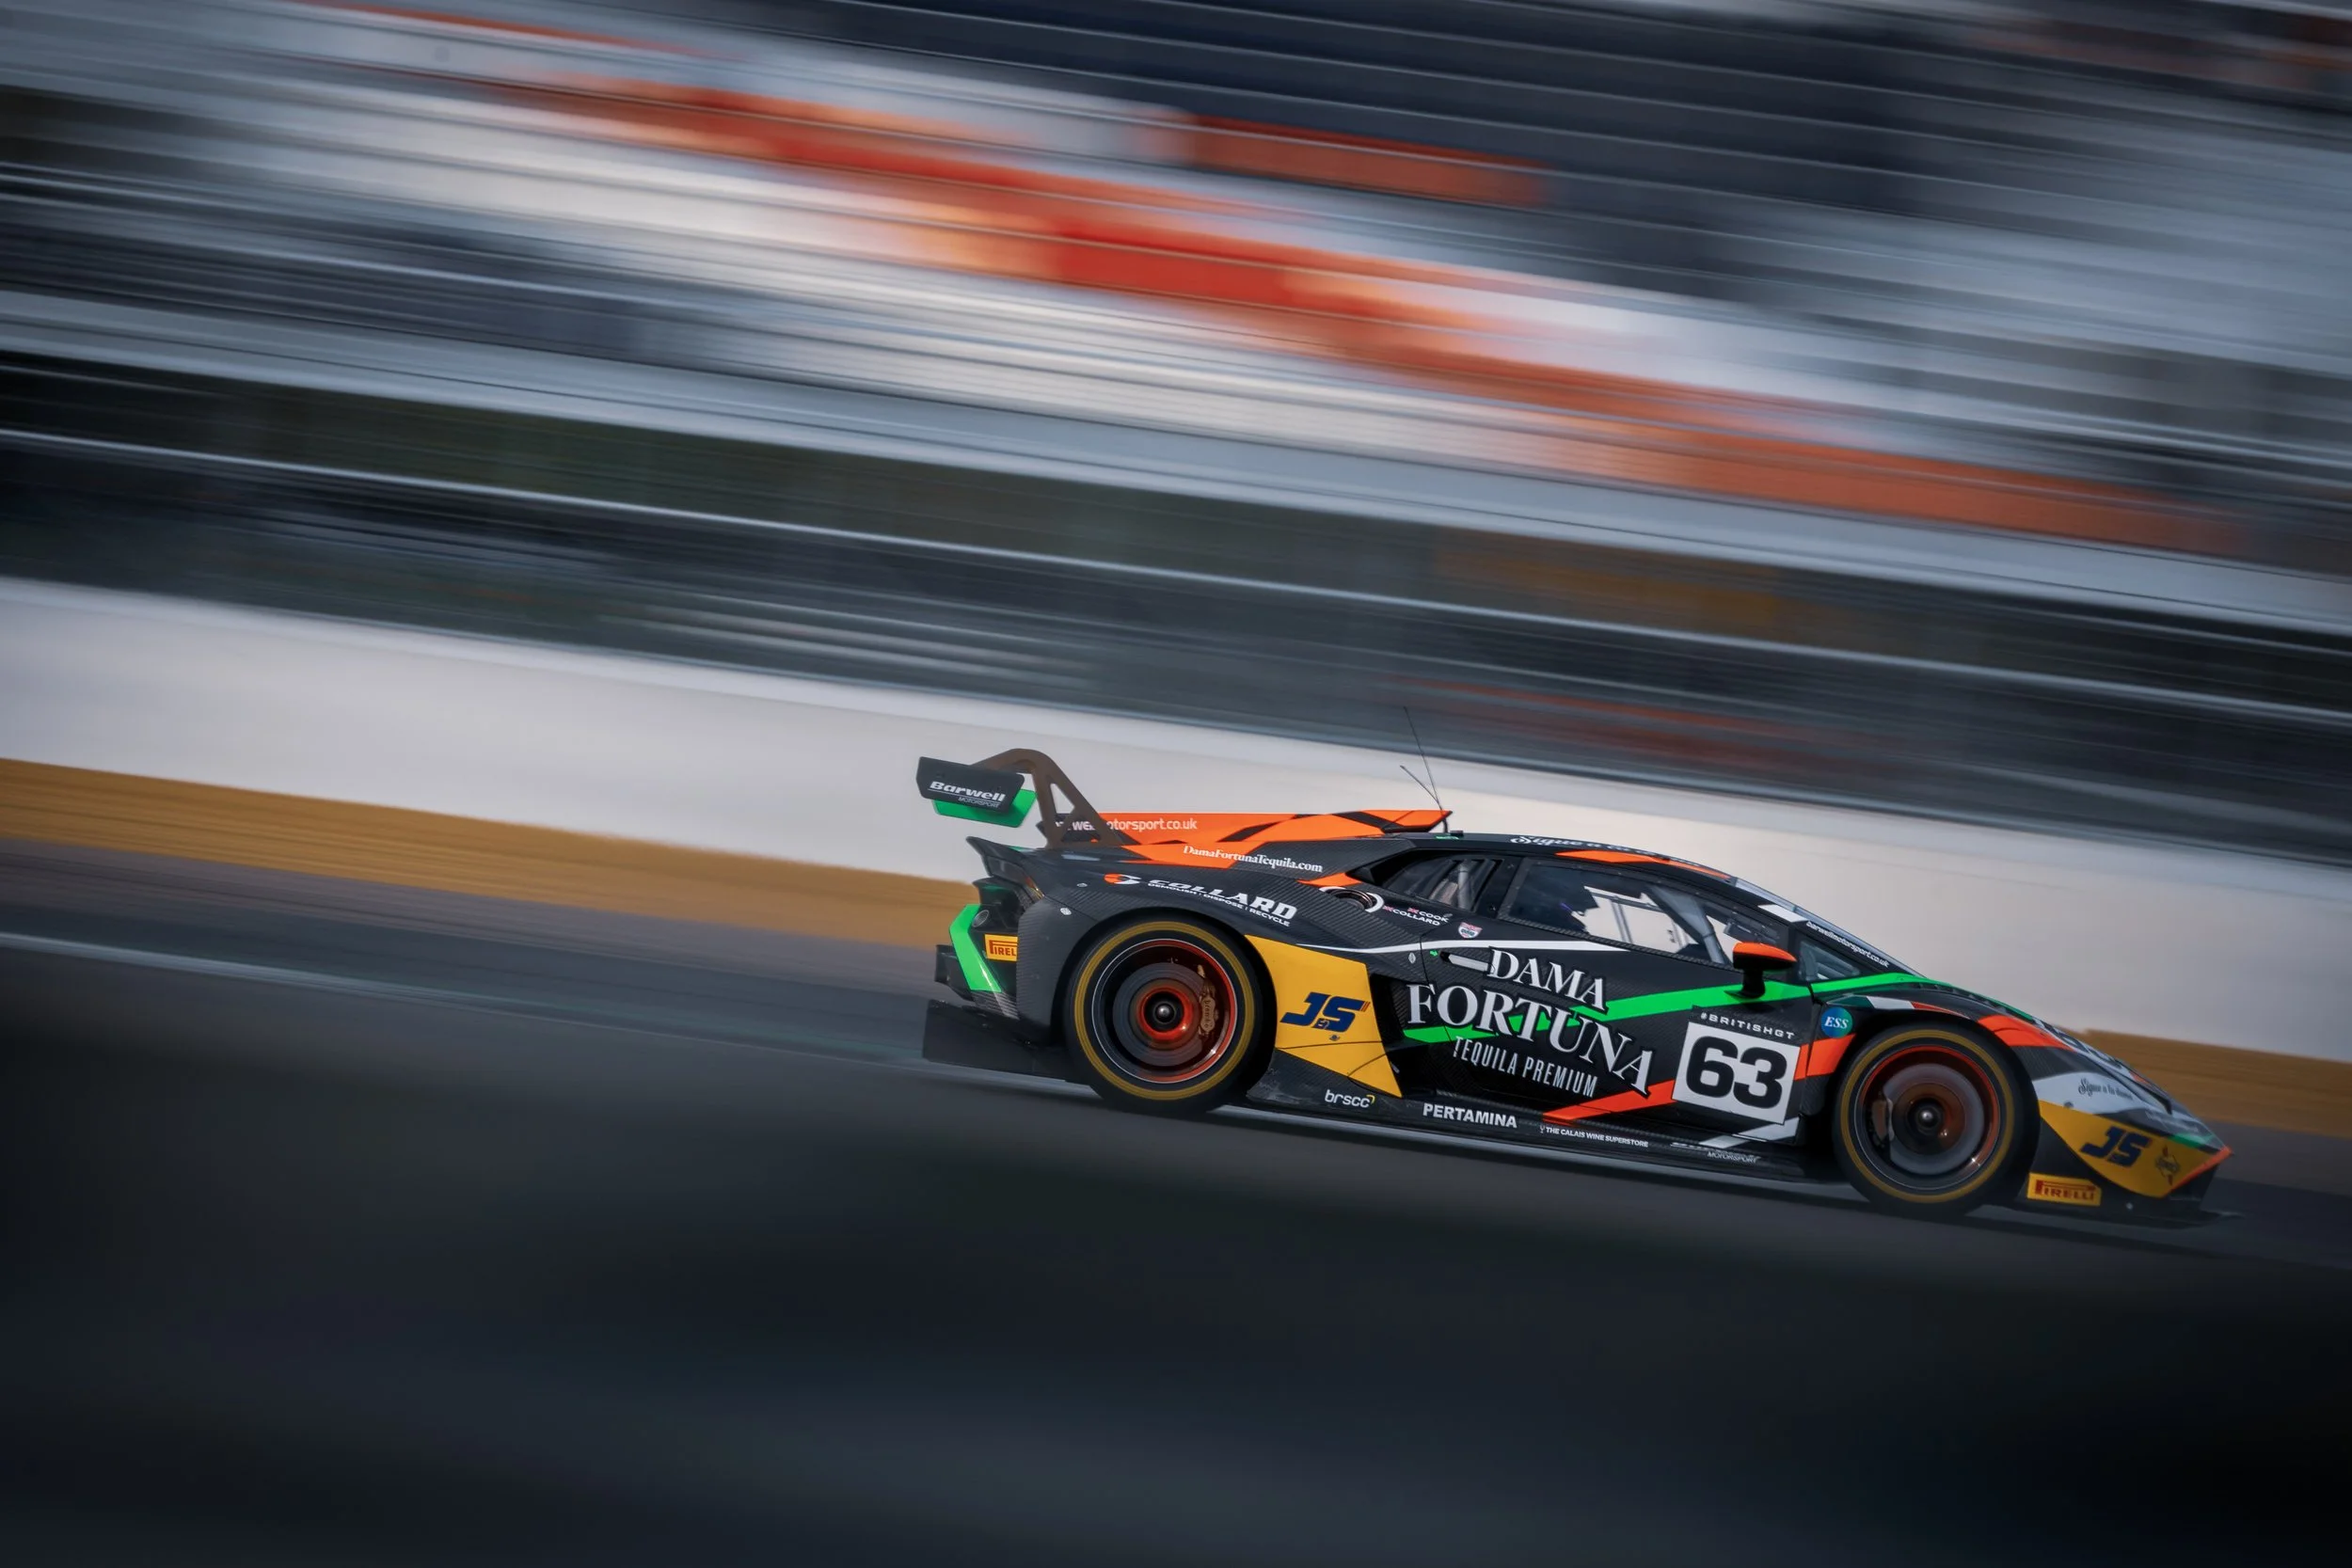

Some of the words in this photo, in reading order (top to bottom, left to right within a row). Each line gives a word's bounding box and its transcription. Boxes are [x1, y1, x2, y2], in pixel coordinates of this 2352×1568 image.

[929, 781, 1007, 802] Barwell
[958, 796, 1001, 808] MOTORSPORT
[1183, 845, 1324, 873] DamaFortunaTequila.com
[1147, 883, 1197, 895] DEMOLISH
[1203, 894, 1245, 911] DISPOSE
[1248, 909, 1291, 927] RECYCLE
[1149, 879, 1298, 920] COLLARD
[1392, 909, 1440, 927] COLLARD
[1419, 911, 1450, 924] COOK
[1486, 948, 1607, 1011] DAMA
[1279, 991, 1367, 1033] JS
[1700, 1012, 1796, 1039] #BRITISHGT
[1823, 1016, 1851, 1030] ESS
[1406, 984, 1653, 1096] FORTUNA
[1452, 1036, 1518, 1076] TEQUILA
[1522, 1055, 1598, 1098] PREMIUM
[1686, 1036, 1788, 1109] 63
[1324, 1089, 1371, 1109] brscc
[1422, 1102, 1518, 1129] PERTAMINA
[1561, 1129, 1585, 1138] CALAIS
[1586, 1132, 1605, 1141] WINE
[1605, 1134, 1649, 1148] SUPERSTORE
[2080, 1125, 2152, 1168] JS
[2034, 1180, 2097, 1201] PIRELLI
